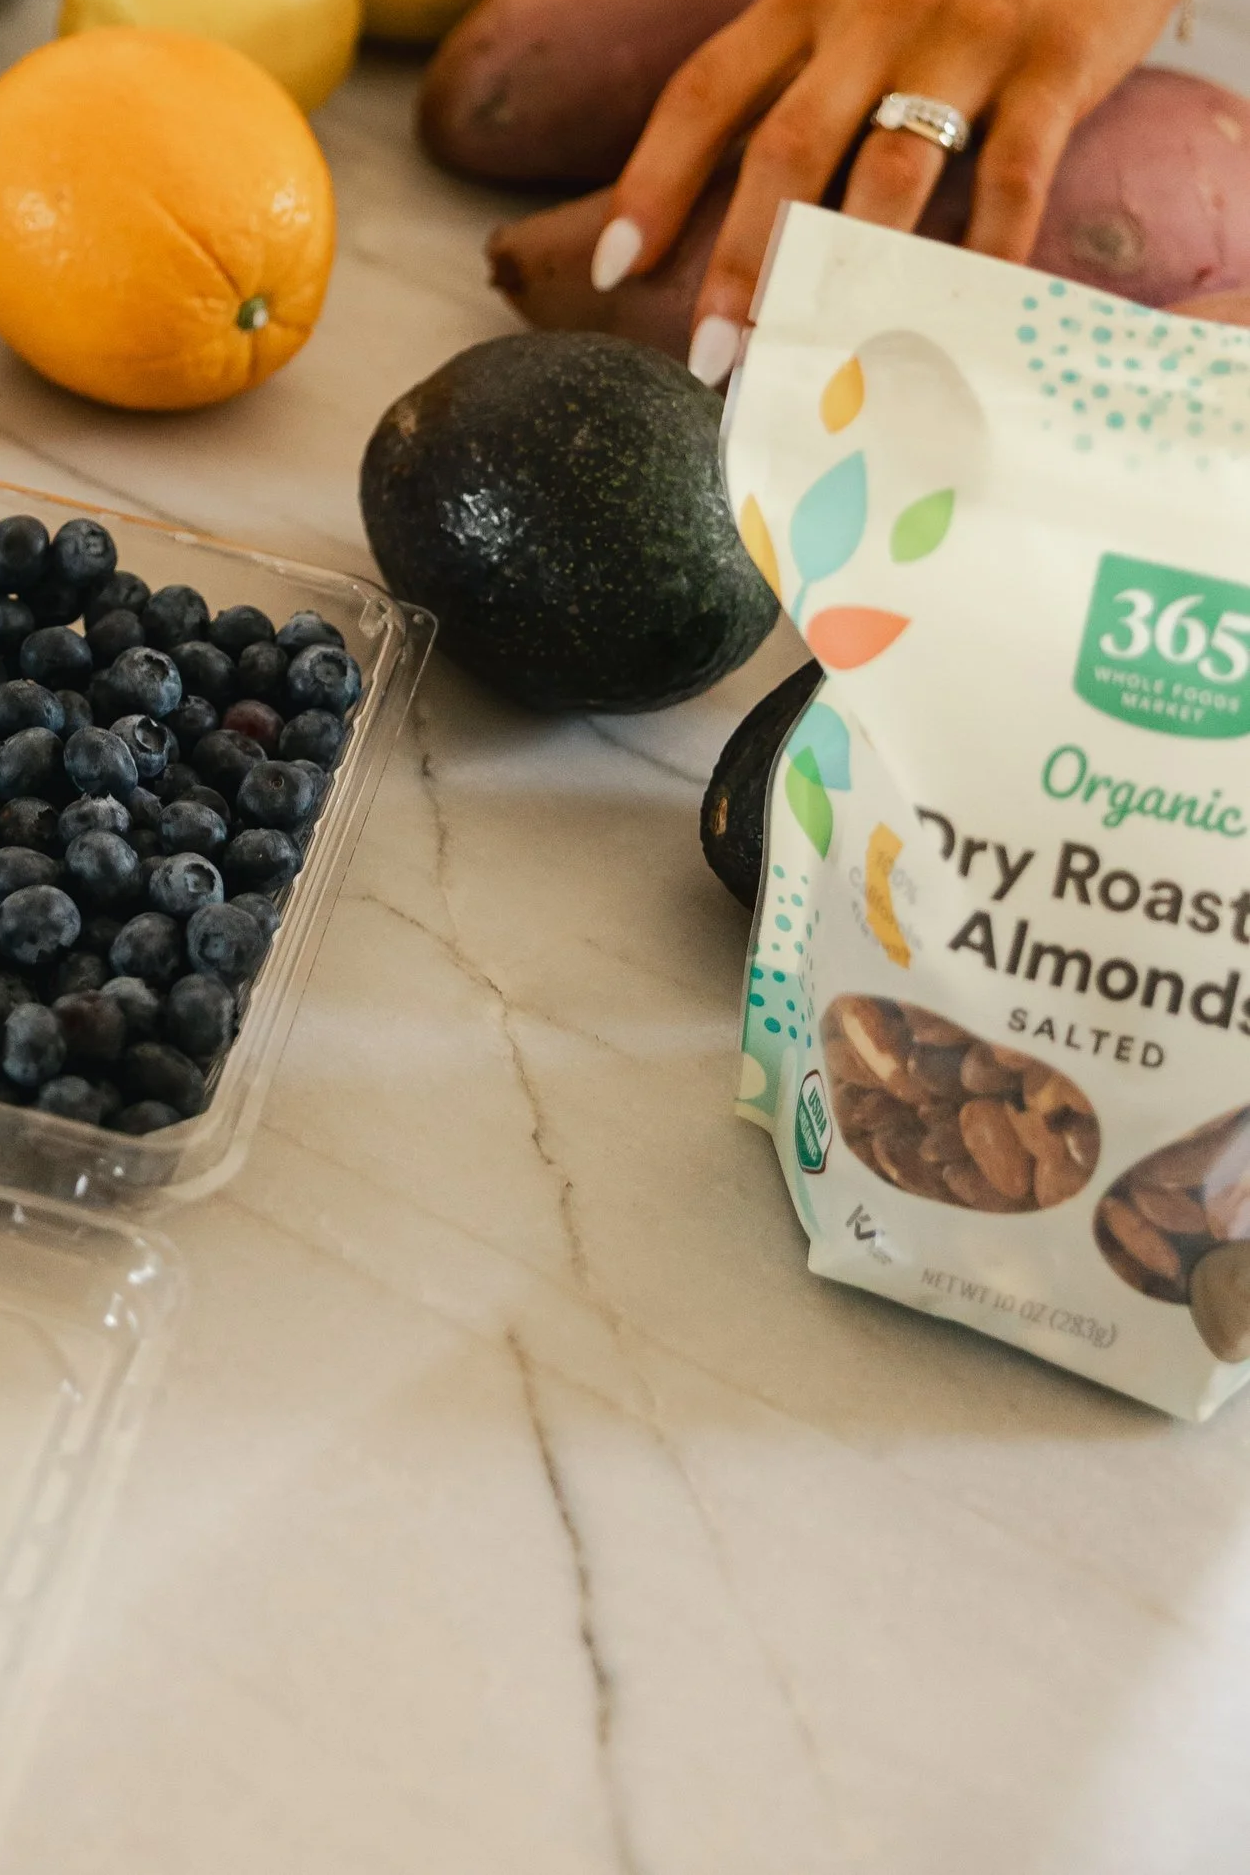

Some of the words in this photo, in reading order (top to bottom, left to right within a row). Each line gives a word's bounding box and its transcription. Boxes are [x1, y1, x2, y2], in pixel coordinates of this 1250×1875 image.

[1100, 588, 1250, 684] 365
[1095, 666, 1165, 695] WHOLE
[1172, 683, 1241, 715] FOODS
[1120, 691, 1206, 723] MARKET
[1041, 744, 1248, 838] Organic
[1007, 1007, 1166, 1069] SALTED
[808, 1086, 828, 1137] USDA
[921, 1268, 958, 1293] NET
[960, 1280, 990, 1305] WT
